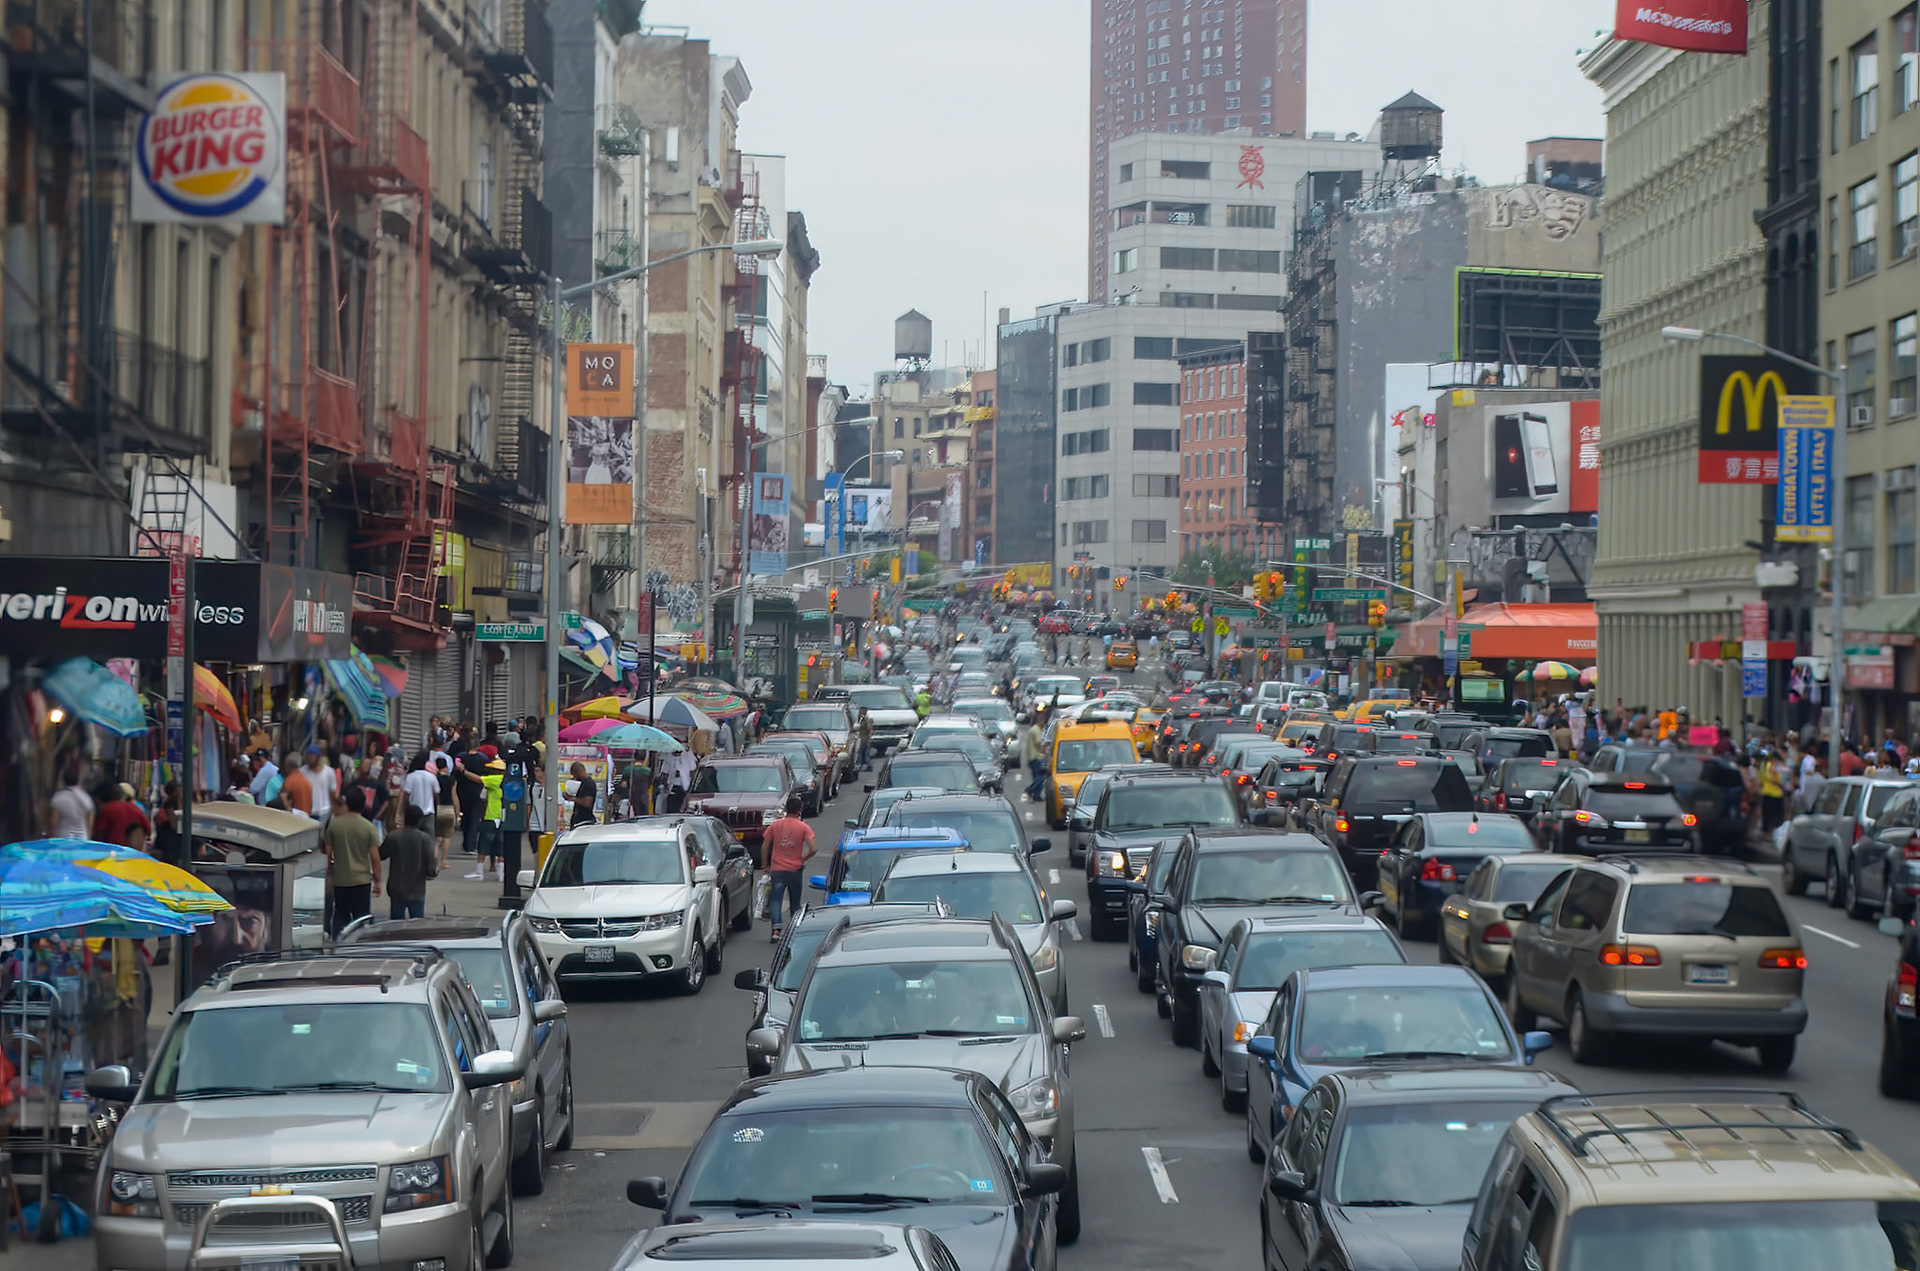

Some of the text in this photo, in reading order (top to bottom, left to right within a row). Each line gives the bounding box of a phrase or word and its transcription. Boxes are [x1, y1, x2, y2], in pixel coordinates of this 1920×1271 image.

[151, 105, 263, 145] BURGER
[153, 130, 266, 184] KING
[1811, 430, 1826, 525] LITTLE ITALY
